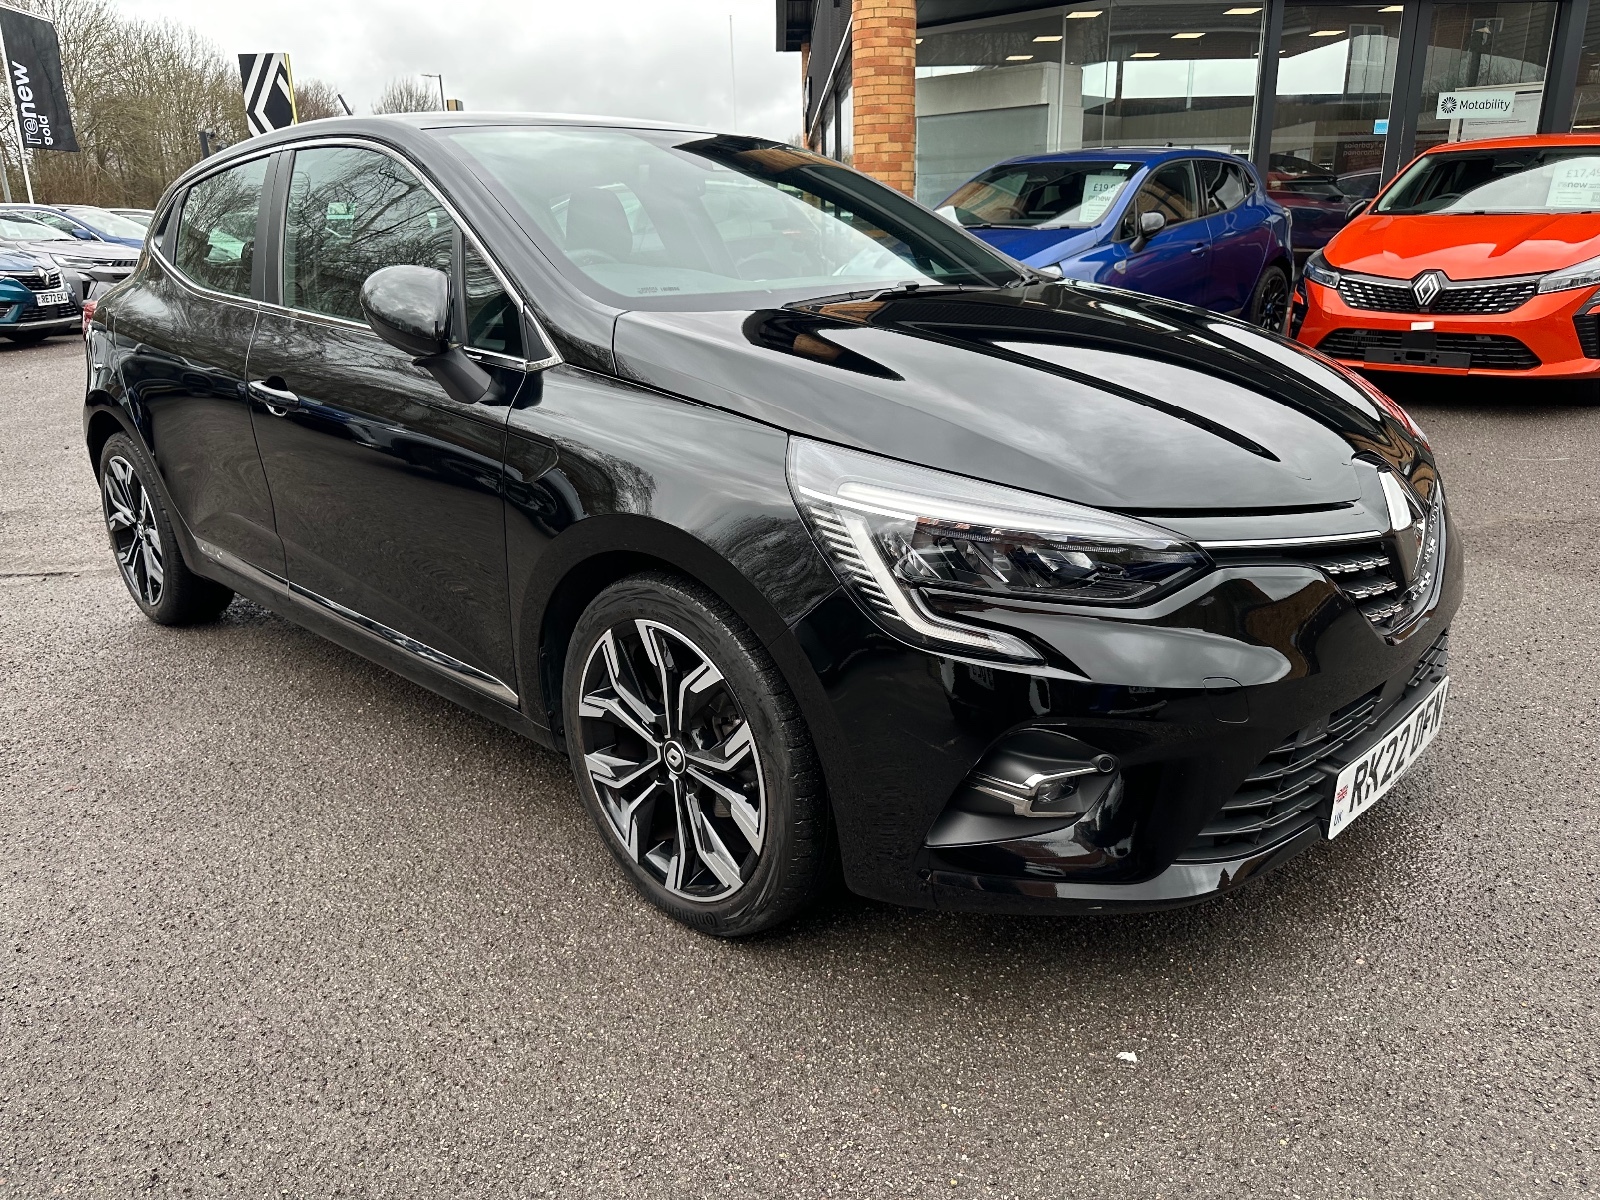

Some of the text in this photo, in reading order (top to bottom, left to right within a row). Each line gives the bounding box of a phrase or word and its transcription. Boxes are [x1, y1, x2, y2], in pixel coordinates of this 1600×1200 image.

[11, 60, 42, 145] renew
[38, 115, 53, 146] gold
[1459, 98, 1511, 112] Motability
[1349, 684, 1446, 813] RK22 DFN
